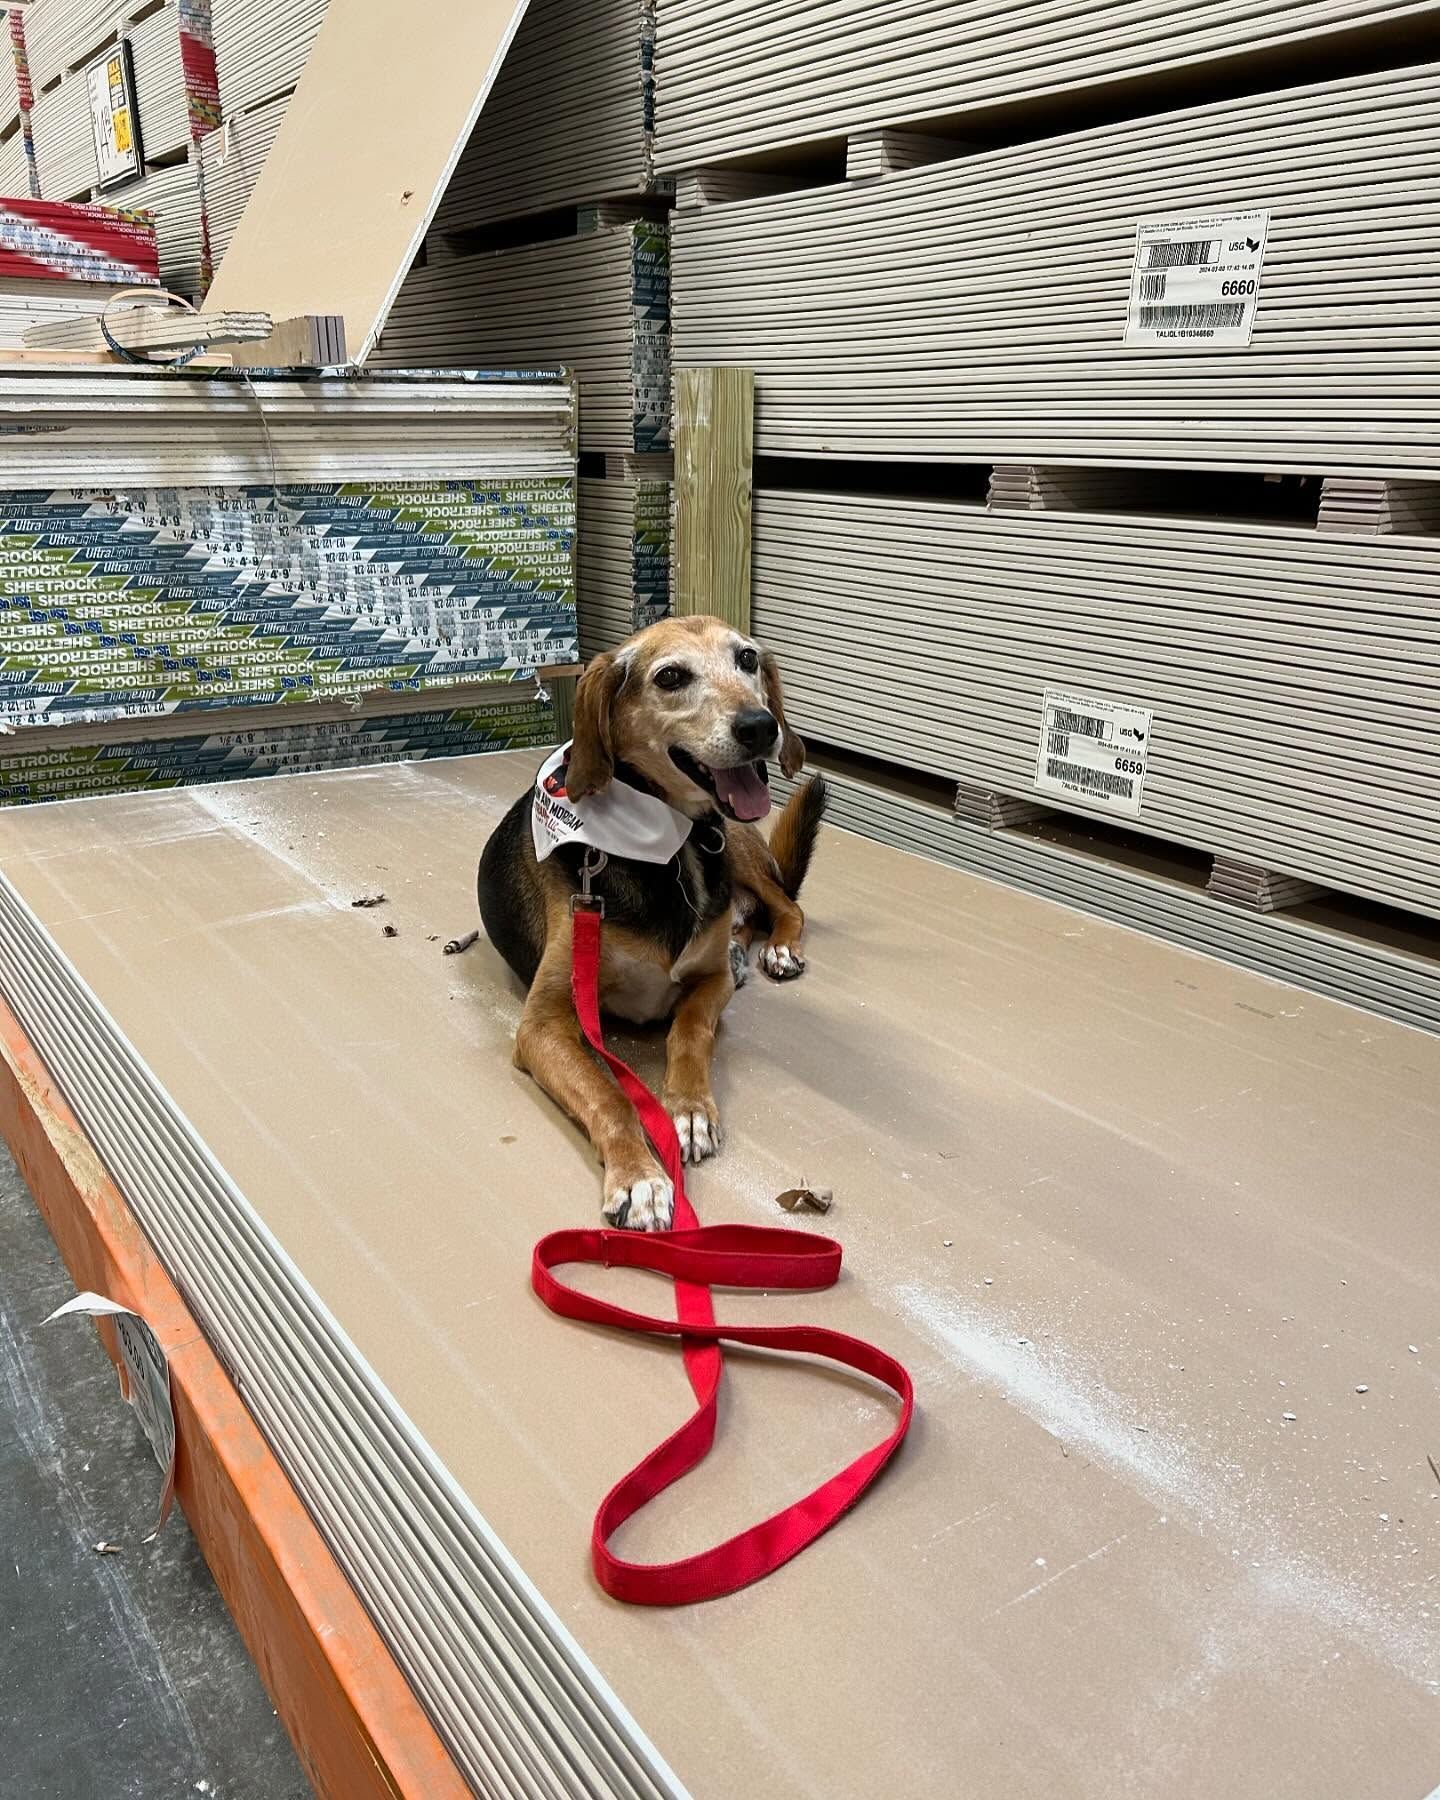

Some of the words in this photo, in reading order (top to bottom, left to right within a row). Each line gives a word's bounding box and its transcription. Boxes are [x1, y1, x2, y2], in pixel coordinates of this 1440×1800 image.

[1228, 241, 1245, 252] USG
[1222, 280, 1256, 296] 6660
[393, 492, 466, 505] SHEETROCK
[506, 489, 571, 501] SHEETROCK
[425, 505, 494, 517] SHEETROCK
[14, 519, 66, 531] UltraLight
[449, 517, 516, 529] SHEETROCK
[49, 533, 99, 545] UltraLight
[477, 529, 541, 541] SHEETROCK
[85, 547, 134, 560] UltraLight
[492, 542, 556, 554] SHEETROCK
[0, 551, 43, 563] ROCK
[103, 561, 151, 573] UltraLight
[4, 578, 97, 593] SHEETROCK
[138, 574, 184, 586] UltraLight
[168, 585, 214, 598] UltraLight
[38, 591, 128, 606] SHEETROCK
[75, 603, 162, 619] SHEETROCK
[232, 611, 276, 623] UltraLight
[109, 616, 194, 632] SHEETROCK
[263, 623, 305, 634] UltraLight
[143, 628, 227, 644] SHEETROCK
[294, 634, 334, 645] UltraLight
[2, 636, 92, 652] SHEETROCK
[176, 639, 258, 656] SHEETROCK
[33, 649, 127, 665] SHEETROCK
[319, 645, 360, 657] UltraLight
[205, 652, 285, 667] SHEETROCK
[69, 660, 156, 677] SHEETROCK
[237, 662, 315, 678] SHEETROCK
[424, 662, 462, 674] UltraLight
[105, 671, 190, 689] SHEETROCK
[319, 666, 396, 684] SHEETROCK
[425, 672, 492, 688] SHEETROCK
[14, 682, 63, 695] UltraLight
[195, 679, 275, 695] SHEETROCK
[110, 689, 155, 702] UltraLight
[1120, 728, 1132, 736] USG
[1114, 758, 1143, 774] 6659
[9, 766, 95, 783] SHEETROCK
[37, 776, 121, 793] SHEETROCK
[550, 802, 584, 831] MORGAN
